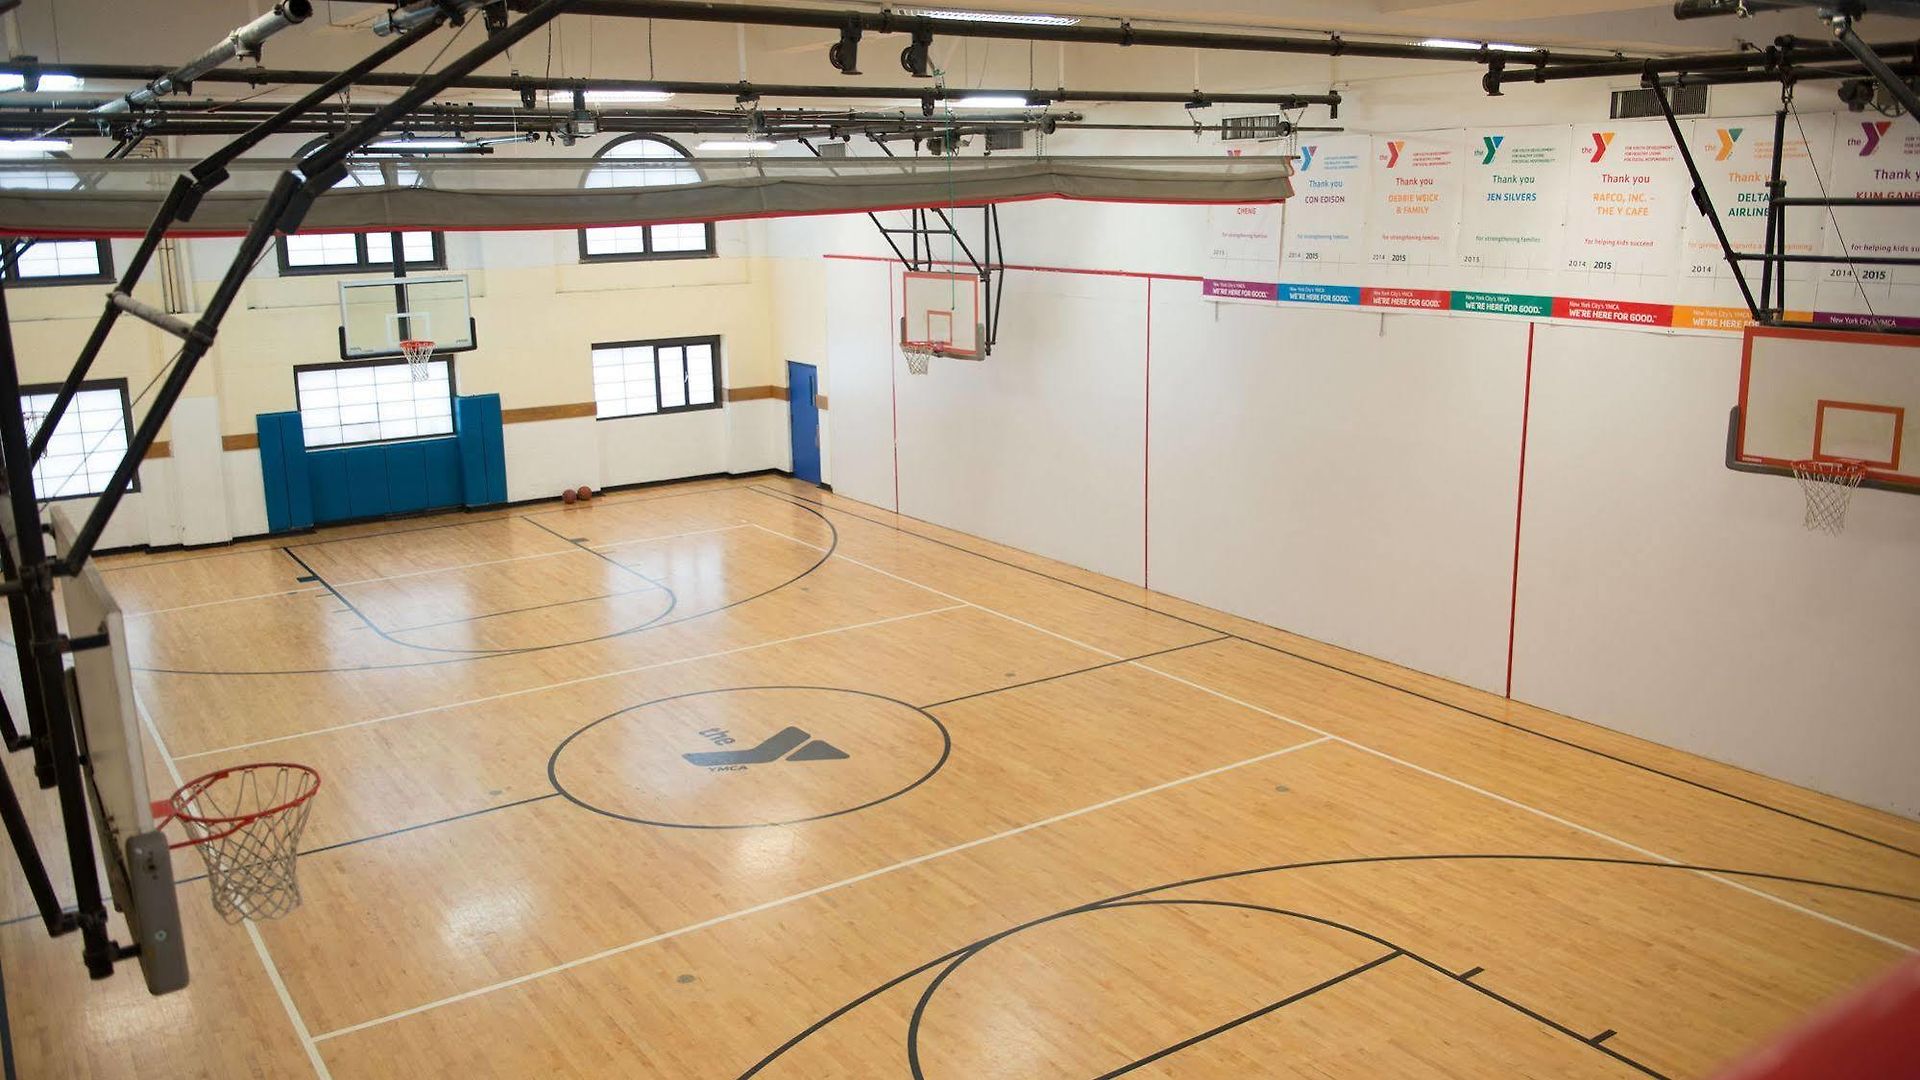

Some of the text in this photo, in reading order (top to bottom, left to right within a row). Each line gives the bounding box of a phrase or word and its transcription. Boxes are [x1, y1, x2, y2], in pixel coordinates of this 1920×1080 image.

[1847, 138, 1861, 146] the
[1474, 148, 1483, 156] the
[1728, 172, 1760, 182] Thank
[1875, 169, 1911, 179] Thank
[1396, 177, 1433, 187] Thank you
[1493, 175, 1535, 185] Thank you
[1602, 174, 1650, 185] Thank you
[1305, 196, 1318, 204] CON
[1487, 193, 1537, 201] JEN SILVERS
[1593, 193, 1625, 203] RAFCO,
[1628, 193, 1647, 202] INC.
[1738, 193, 1771, 202] DELTA
[1403, 206, 1429, 214] FAMILY
[1597, 207, 1615, 215] THE
[1617, 207, 1623, 215] Y
[1728, 208, 1769, 217] AIRLINE
[1851, 243, 1862, 251] for
[1863, 244, 1891, 252] helping
[1593, 261, 1612, 270] 2015
[1691, 265, 1712, 273] 2014
[1830, 269, 1886, 280] 2014 2015
[1465, 301, 1485, 310] WE'RE
[1486, 303, 1503, 311] HERE
[1504, 304, 1518, 313] FOR
[1569, 309, 1591, 318] WE'RE
[1593, 310, 1612, 319] HERE
[1613, 312, 1629, 320] FOR
[1692, 318, 1717, 327] WE'RE
[1719, 319, 1741, 328] HERE
[1830, 316, 1843, 324] New
[698, 727, 736, 746] the
[707, 764, 748, 772] YMCA
